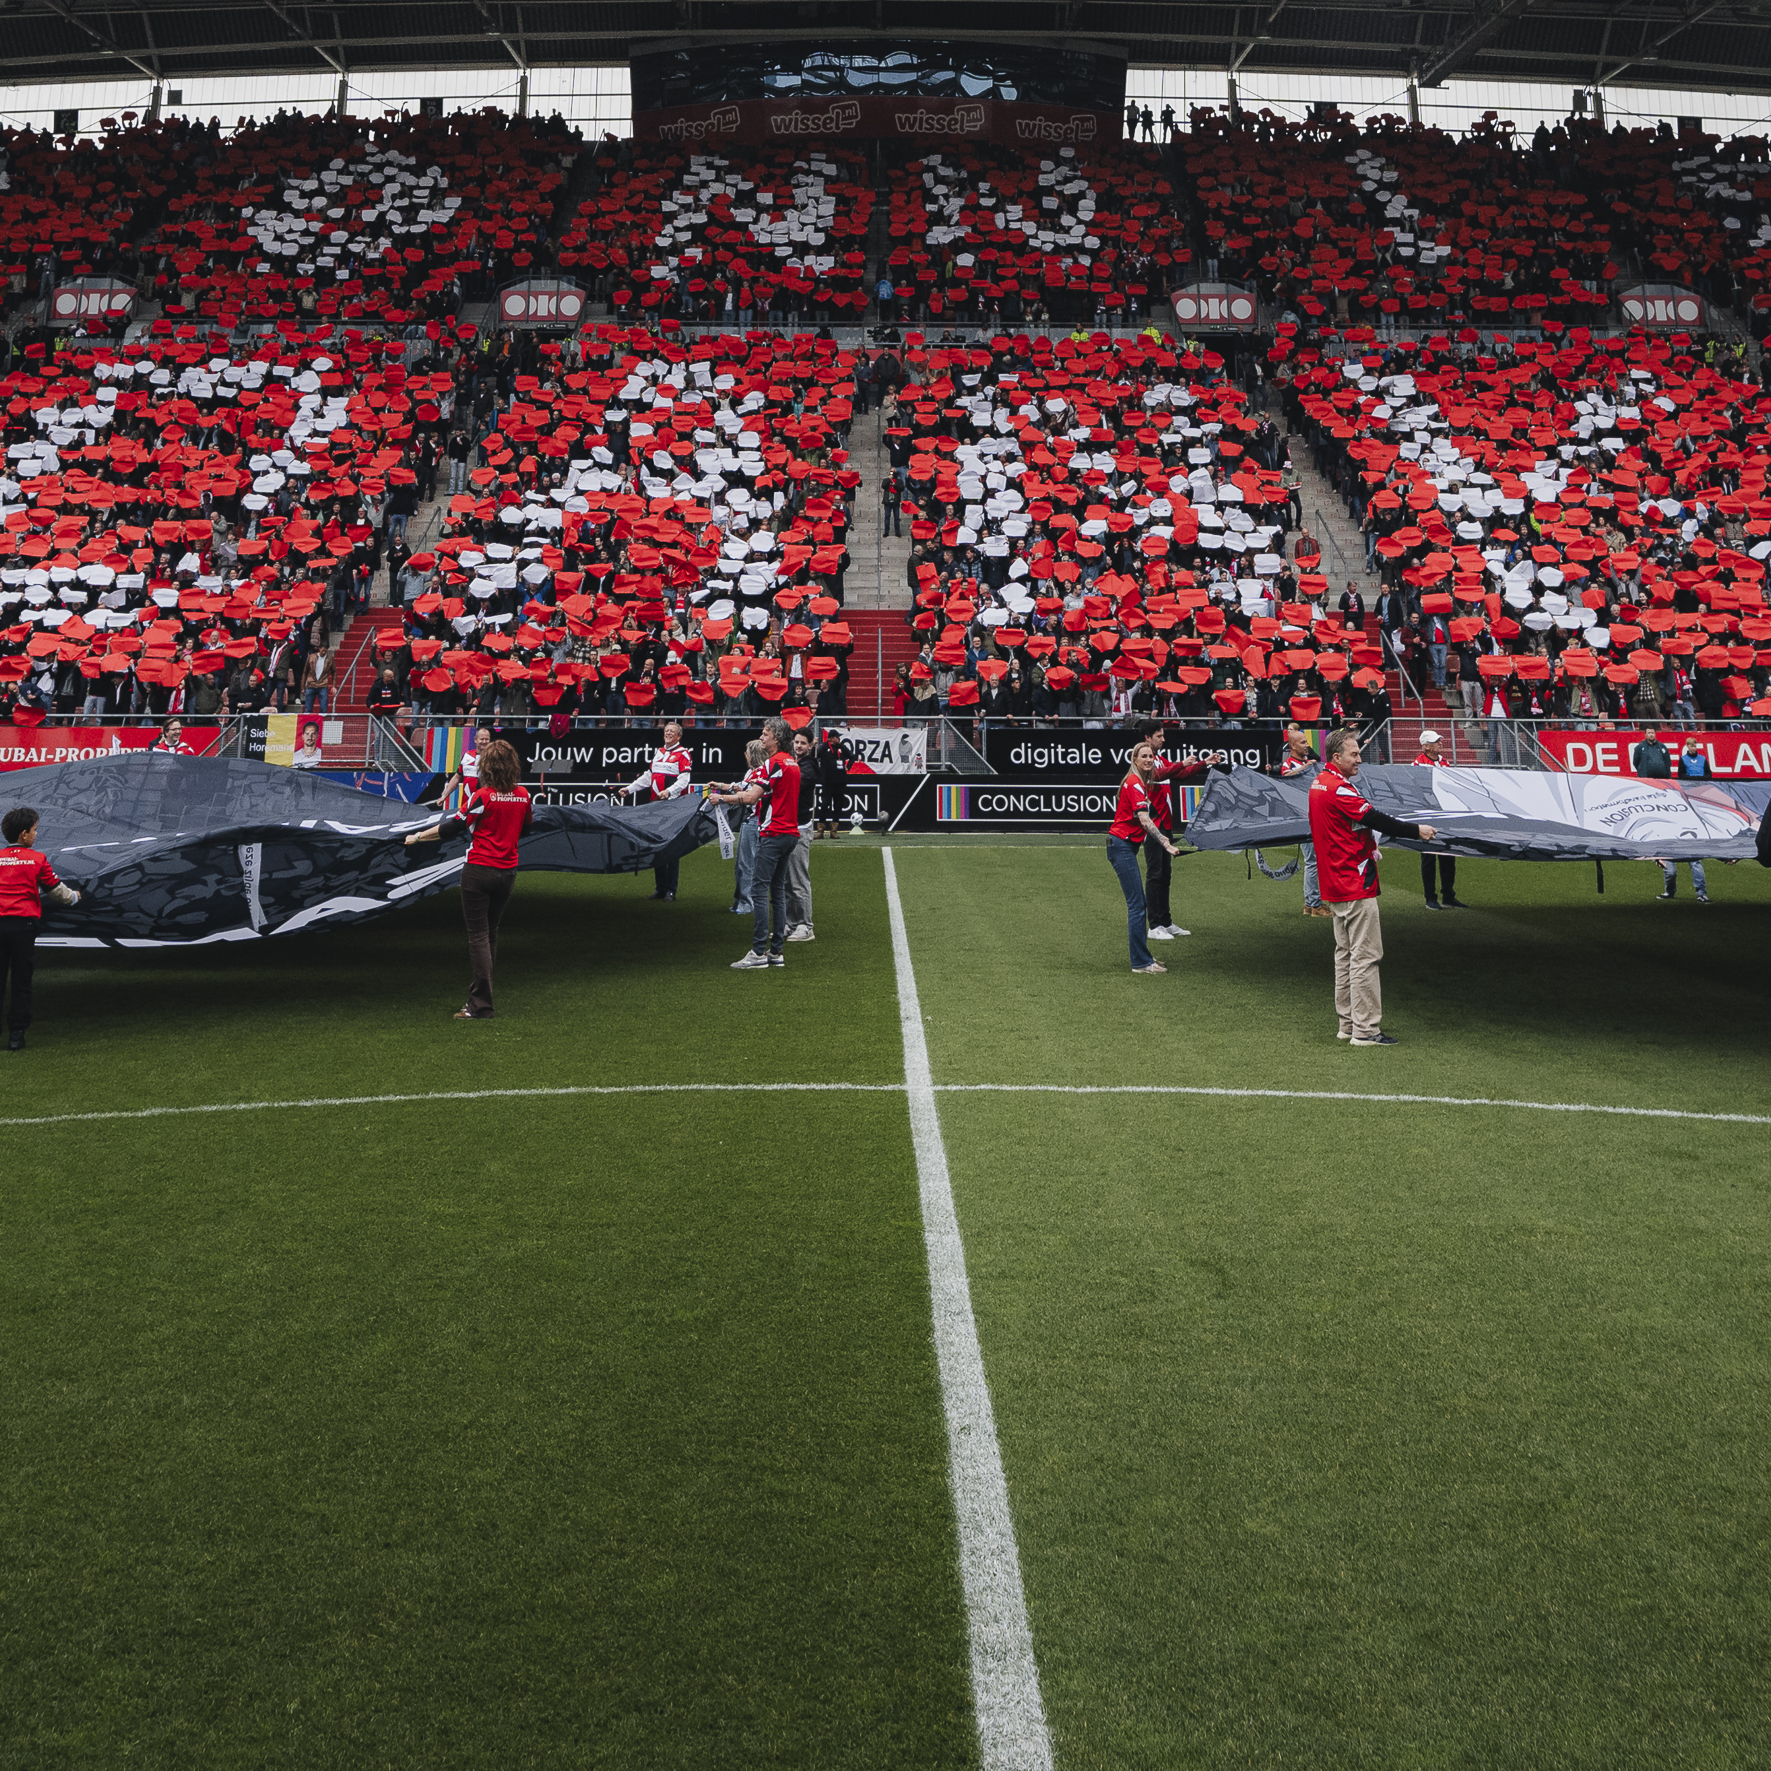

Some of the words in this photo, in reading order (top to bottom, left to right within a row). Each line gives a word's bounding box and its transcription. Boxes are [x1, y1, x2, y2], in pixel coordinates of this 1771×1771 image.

[659, 106, 739, 140] wissel.nl
[772, 101, 860, 134] wissel.nl
[896, 103, 984, 134] wissel.nl
[1016, 115, 1096, 142] wissel.nl
[250, 728, 276, 738] Siebe
[527, 743, 594, 762] Jouw
[702, 743, 723, 763] in
[842, 738, 893, 764] ORZA
[1010, 743, 1103, 770] digitale
[1110, 743, 1261, 771] voruitgang
[1566, 743, 1619, 772] DE
[978, 795, 1116, 813] CONCLUSION
[1599, 803, 1689, 827] CONCLUSION
